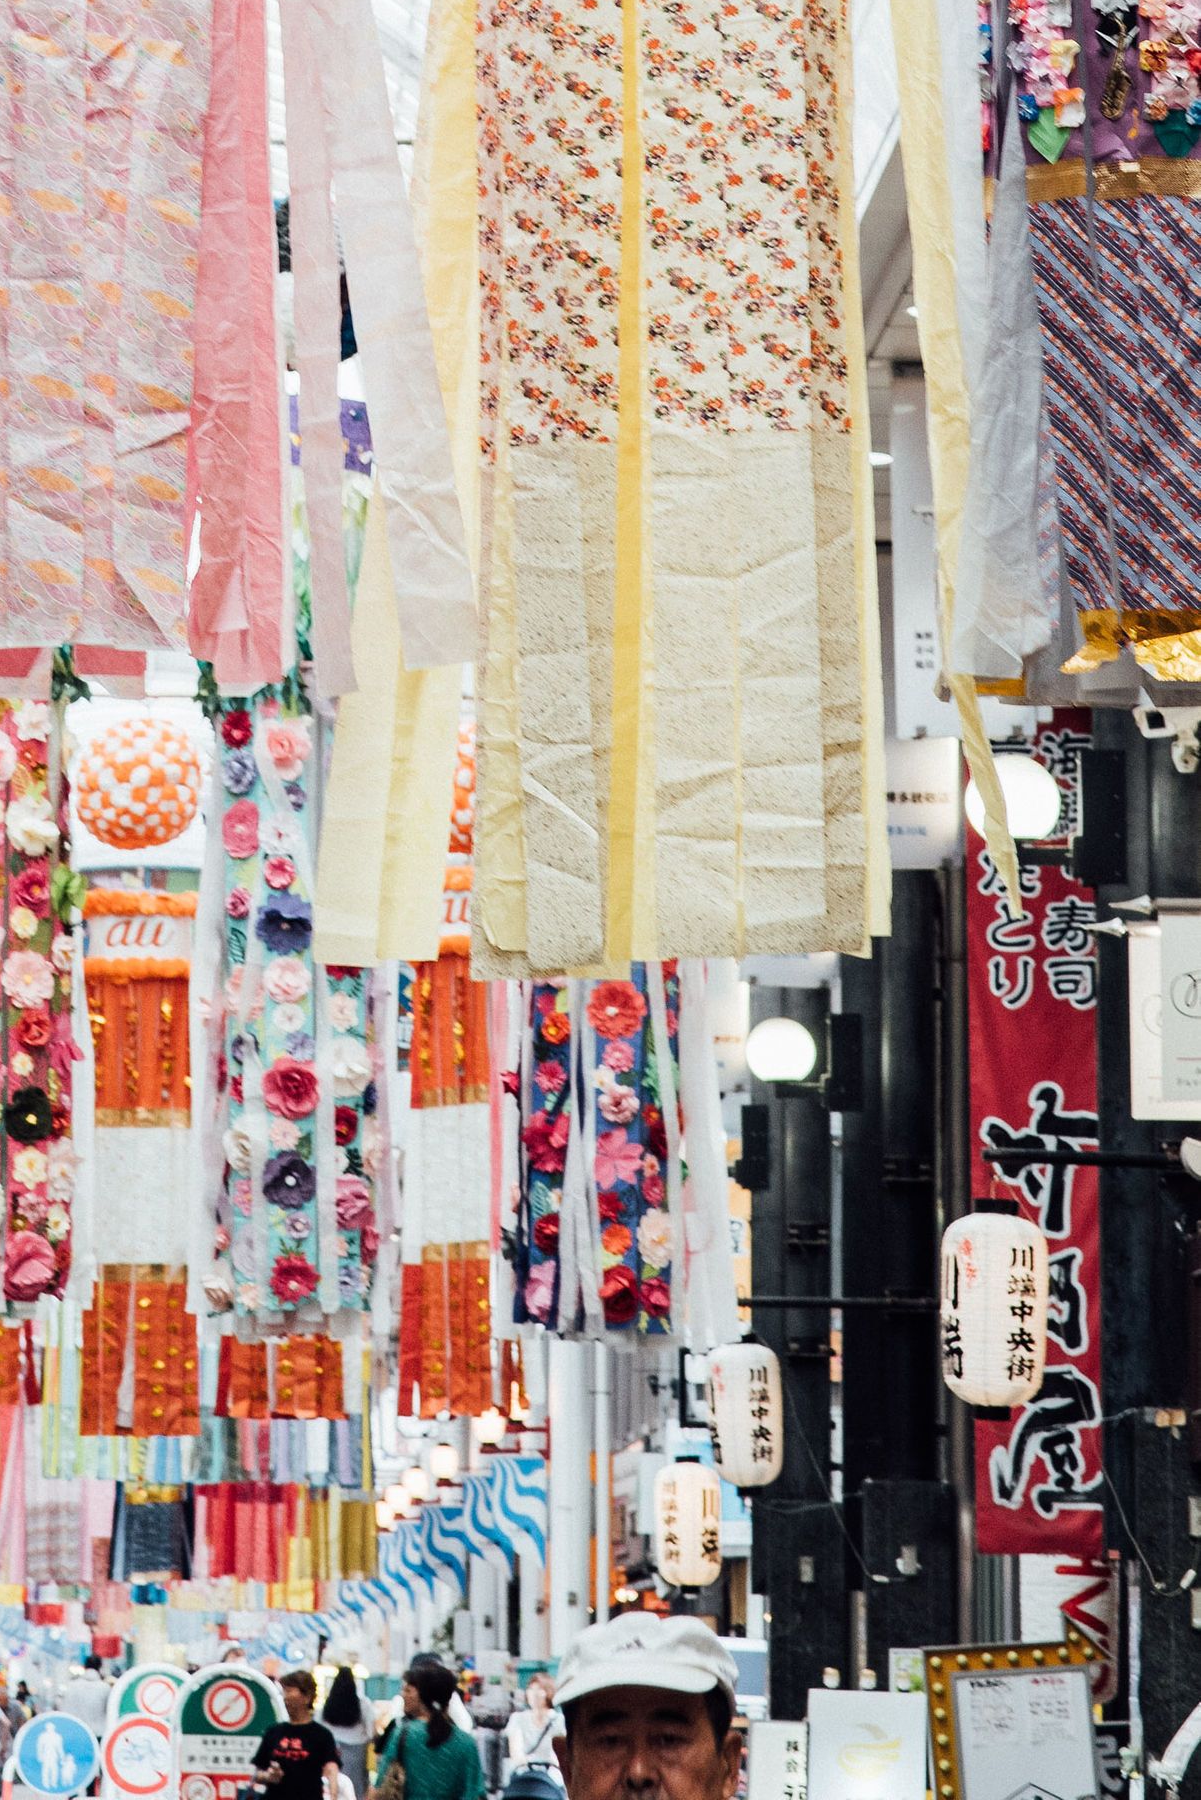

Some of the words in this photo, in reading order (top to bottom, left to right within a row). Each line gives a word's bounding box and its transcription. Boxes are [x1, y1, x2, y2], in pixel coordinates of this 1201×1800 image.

[106, 919, 164, 947] au
[1006, 1245, 1036, 1382] 川端中央街
